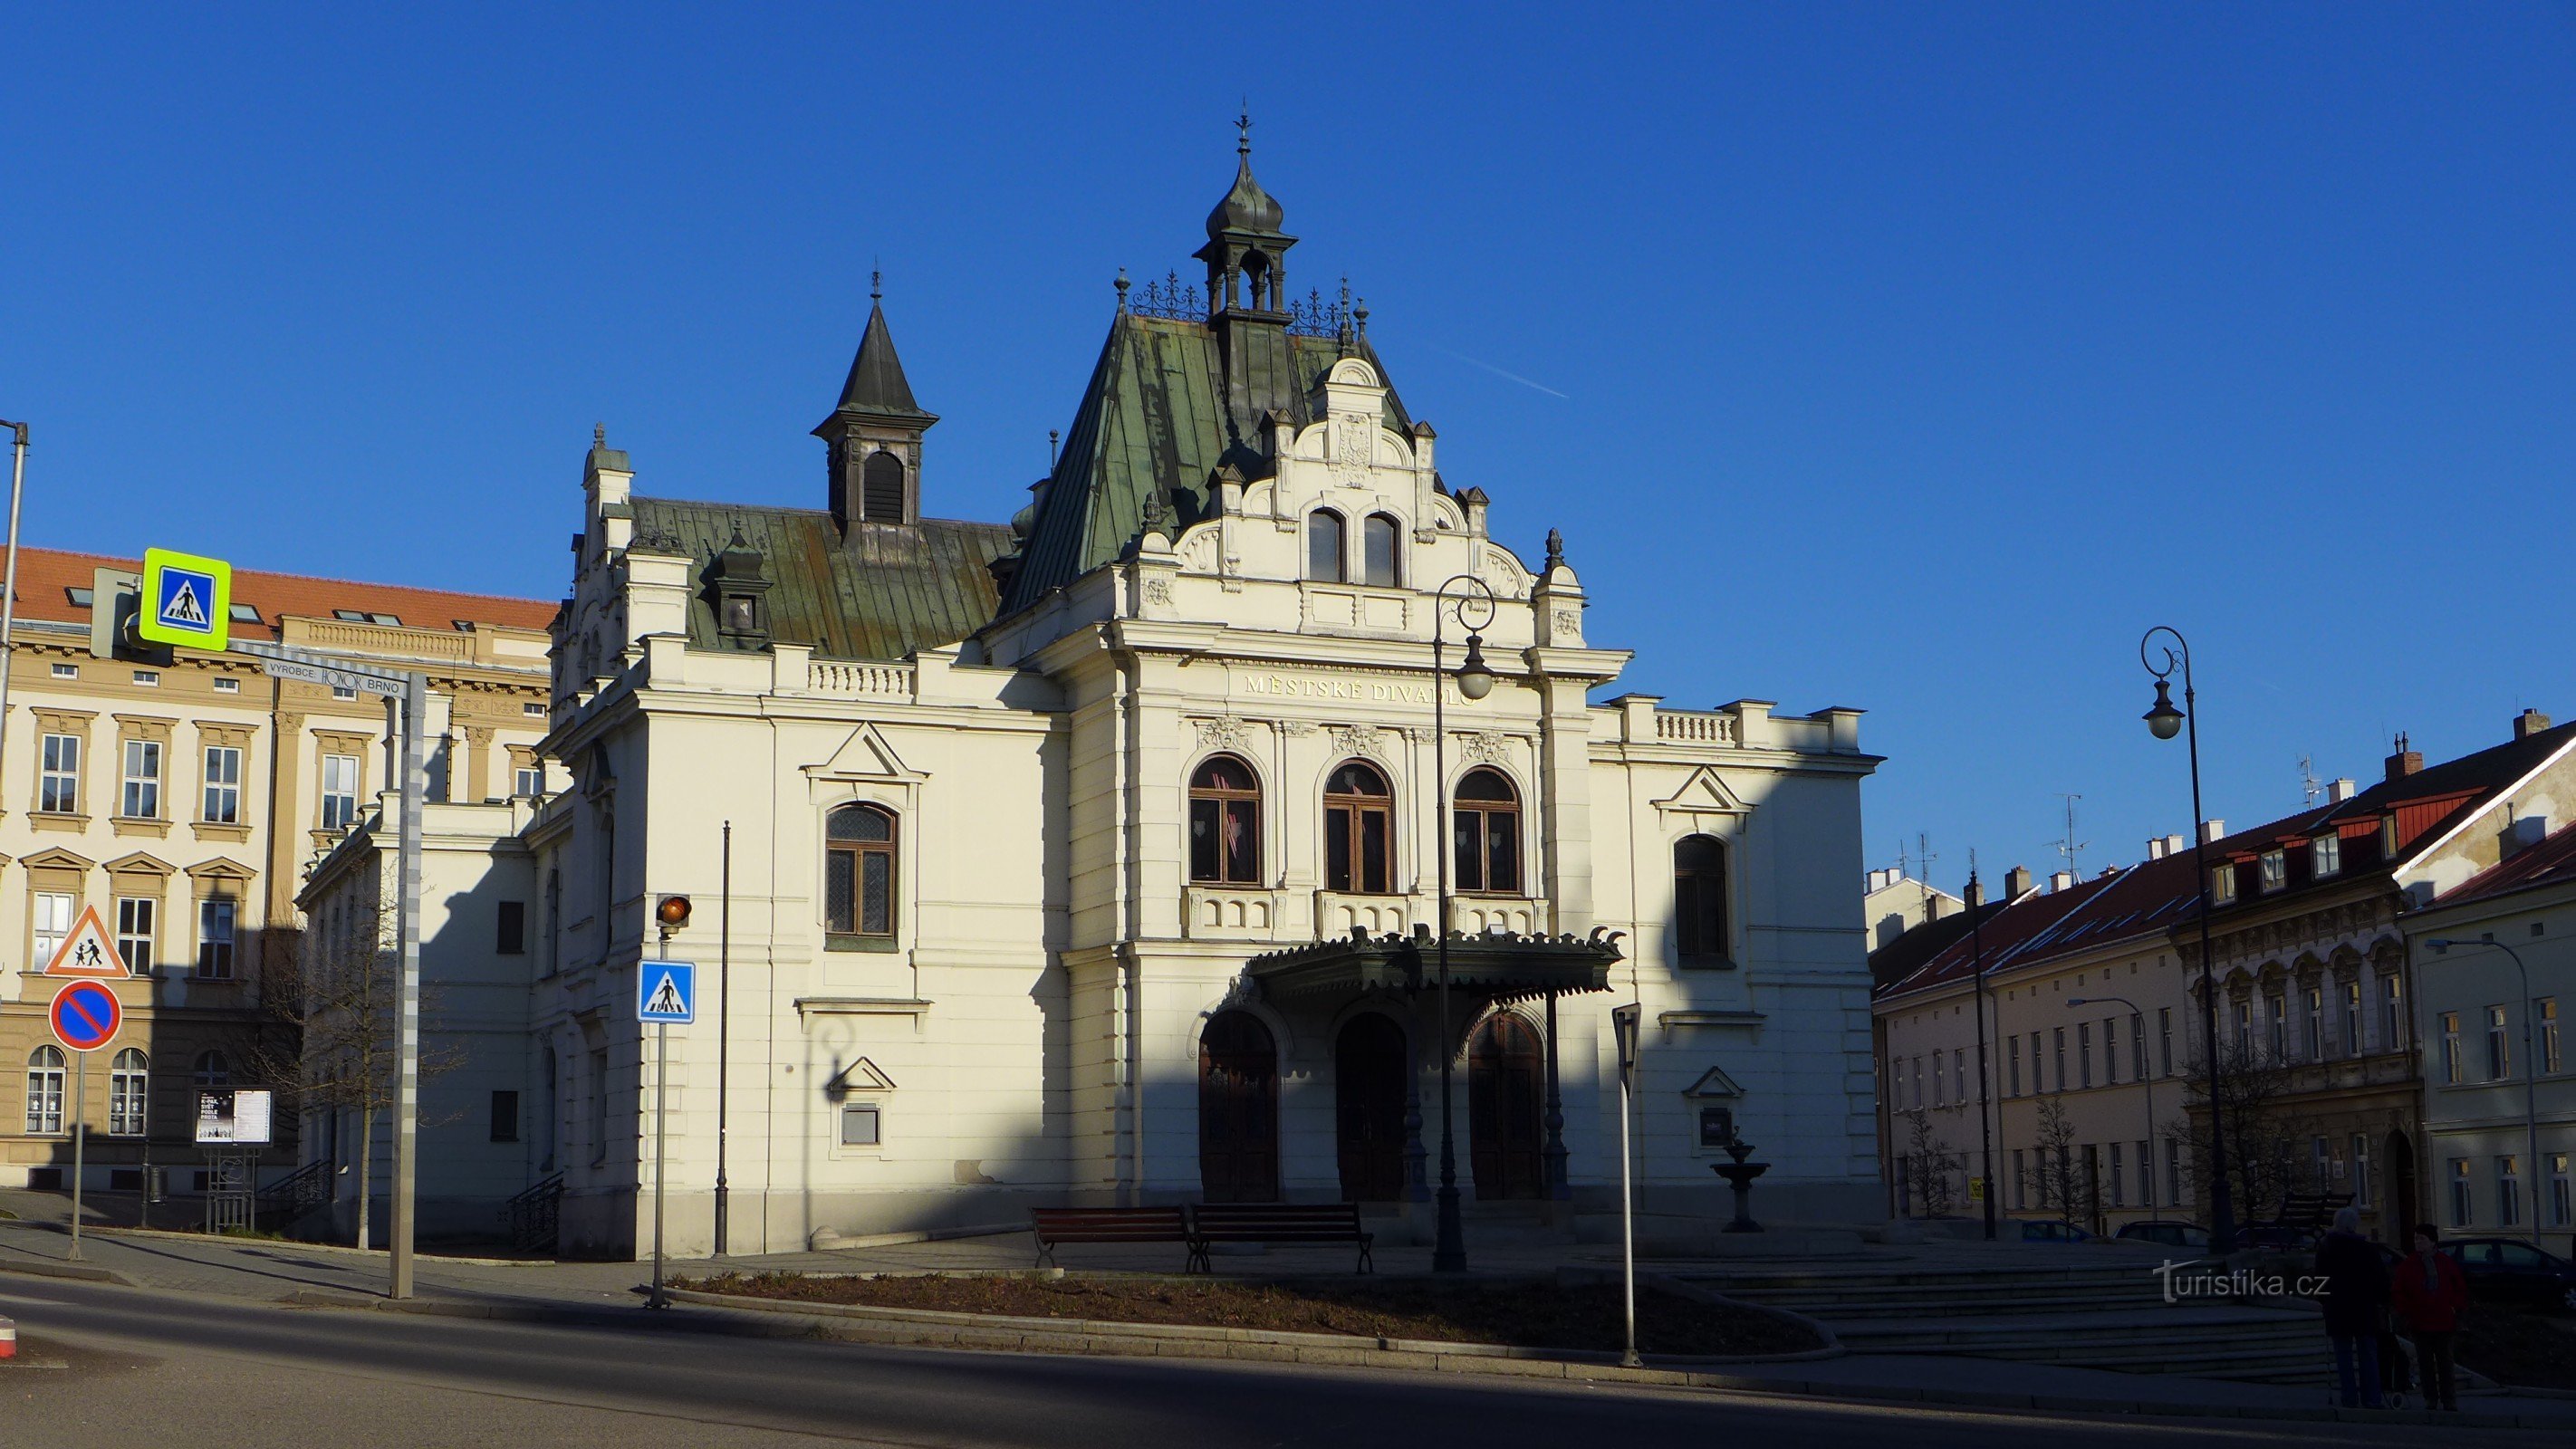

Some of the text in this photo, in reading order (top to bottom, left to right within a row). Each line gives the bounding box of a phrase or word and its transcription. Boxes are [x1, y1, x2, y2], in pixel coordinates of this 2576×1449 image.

[270, 663, 399, 694] VÝROBCE: HONOR BRNO
[1245, 675, 1363, 700] MĚSTSKÉ
